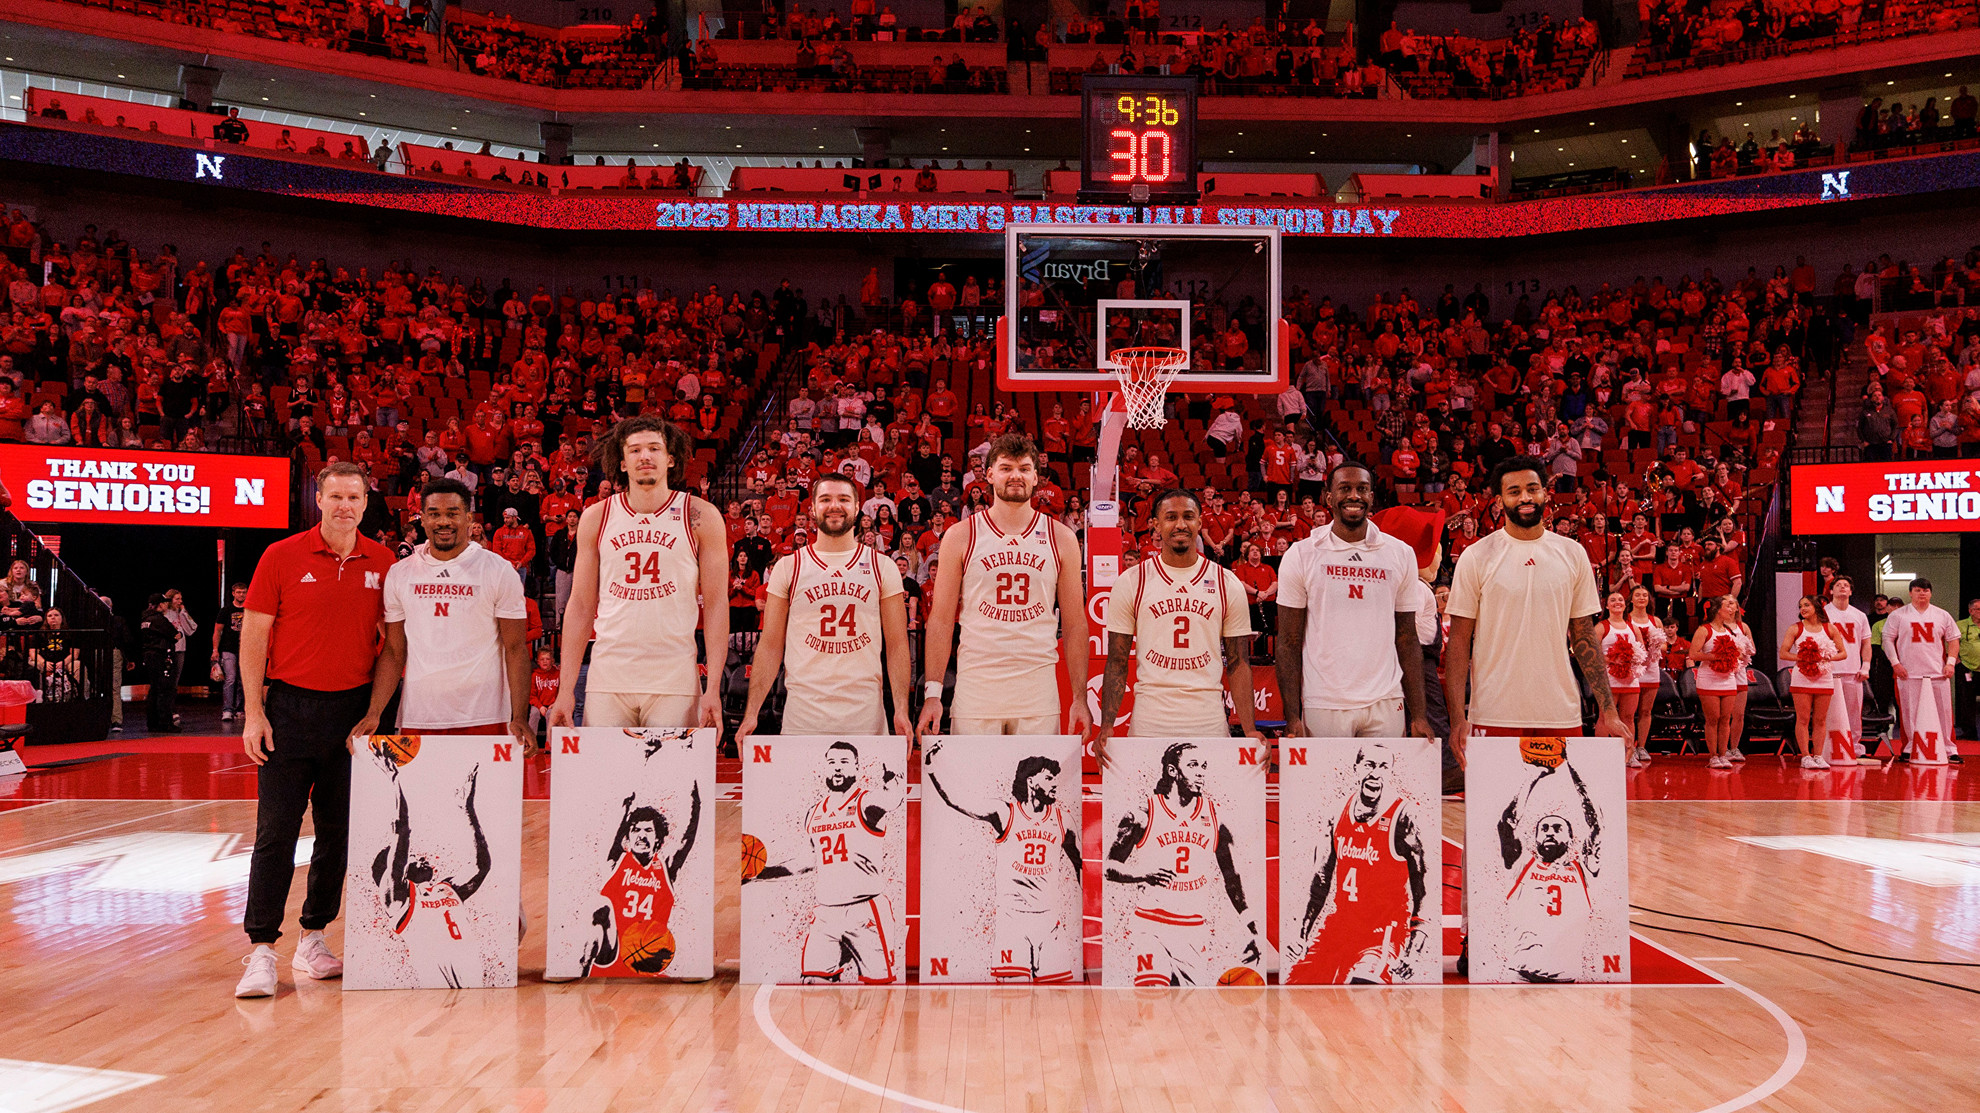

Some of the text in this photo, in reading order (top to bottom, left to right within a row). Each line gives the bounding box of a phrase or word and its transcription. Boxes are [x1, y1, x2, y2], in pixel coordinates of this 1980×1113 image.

[579, 8, 612, 21] 210
[1170, 15, 1201, 28] 212
[1506, 12, 1539, 29] 213
[1117, 96, 1178, 126] 9:36
[195, 153, 226, 180] N
[1111, 130, 1170, 182] 30
[1821, 171, 1850, 199] N
[656, 203, 1401, 233] 2025 NEBRASKA MEN'S BASKETALL SENIOR DAY
[603, 274, 639, 289] 111
[1175, 279, 1209, 294] 112
[1505, 279, 1540, 295] 113
[1275, 450, 1286, 466] 5
[46, 458, 196, 483] THANK YOU
[1884, 471, 1971, 491] THANK
[26, 479, 211, 514] SENIORS!
[234, 477, 265, 505] N
[1815, 485, 1845, 513] N
[610, 529, 677, 551] NEBRASKA
[625, 551, 660, 584] 34
[980, 551, 1046, 572] NEBRASKA
[1326, 565, 1387, 580] NEBRASKA
[364, 570, 381, 590] N
[414, 584, 474, 597] NEBRASKA
[608, 581, 677, 600] CORNHUSKERS
[996, 572, 1030, 605] 23
[804, 582, 871, 604] NEBRASKA
[1348, 584, 1364, 600] N
[433, 602, 450, 617] N
[820, 603, 856, 637] 24
[978, 600, 1045, 622] CORNHUSKERS
[1149, 597, 1215, 621] NEBRASKA
[804, 632, 872, 654] CORNHUSKERS
[1173, 615, 1190, 649] 2
[1910, 621, 1935, 643] N
[1145, 649, 1212, 671] CORNHUSKERS
[493, 743, 512, 762] N
[561, 736, 580, 754] N
[753, 745, 772, 763] N
[1238, 747, 1257, 765] N
[1288, 747, 1307, 765] N
[1829, 730, 1857, 761] N
[1911, 731, 1938, 761] N
[811, 820, 857, 834] NEBRASKA
[1015, 829, 1057, 845] NEBRASKA
[819, 832, 849, 865] 24
[1156, 830, 1210, 850] NEBRASKA
[1336, 835, 1380, 866] Nebraska
[1023, 843, 1047, 865] 23
[1175, 846, 1190, 874] 2
[622, 867, 662, 893] Nebraska
[1342, 867, 1358, 902] 4
[622, 890, 655, 921] 34
[1546, 884, 1562, 916] 3
[930, 957, 949, 976] N
[1000, 950, 1013, 964] N
[1137, 953, 1153, 972] N
[1602, 954, 1621, 973] N
